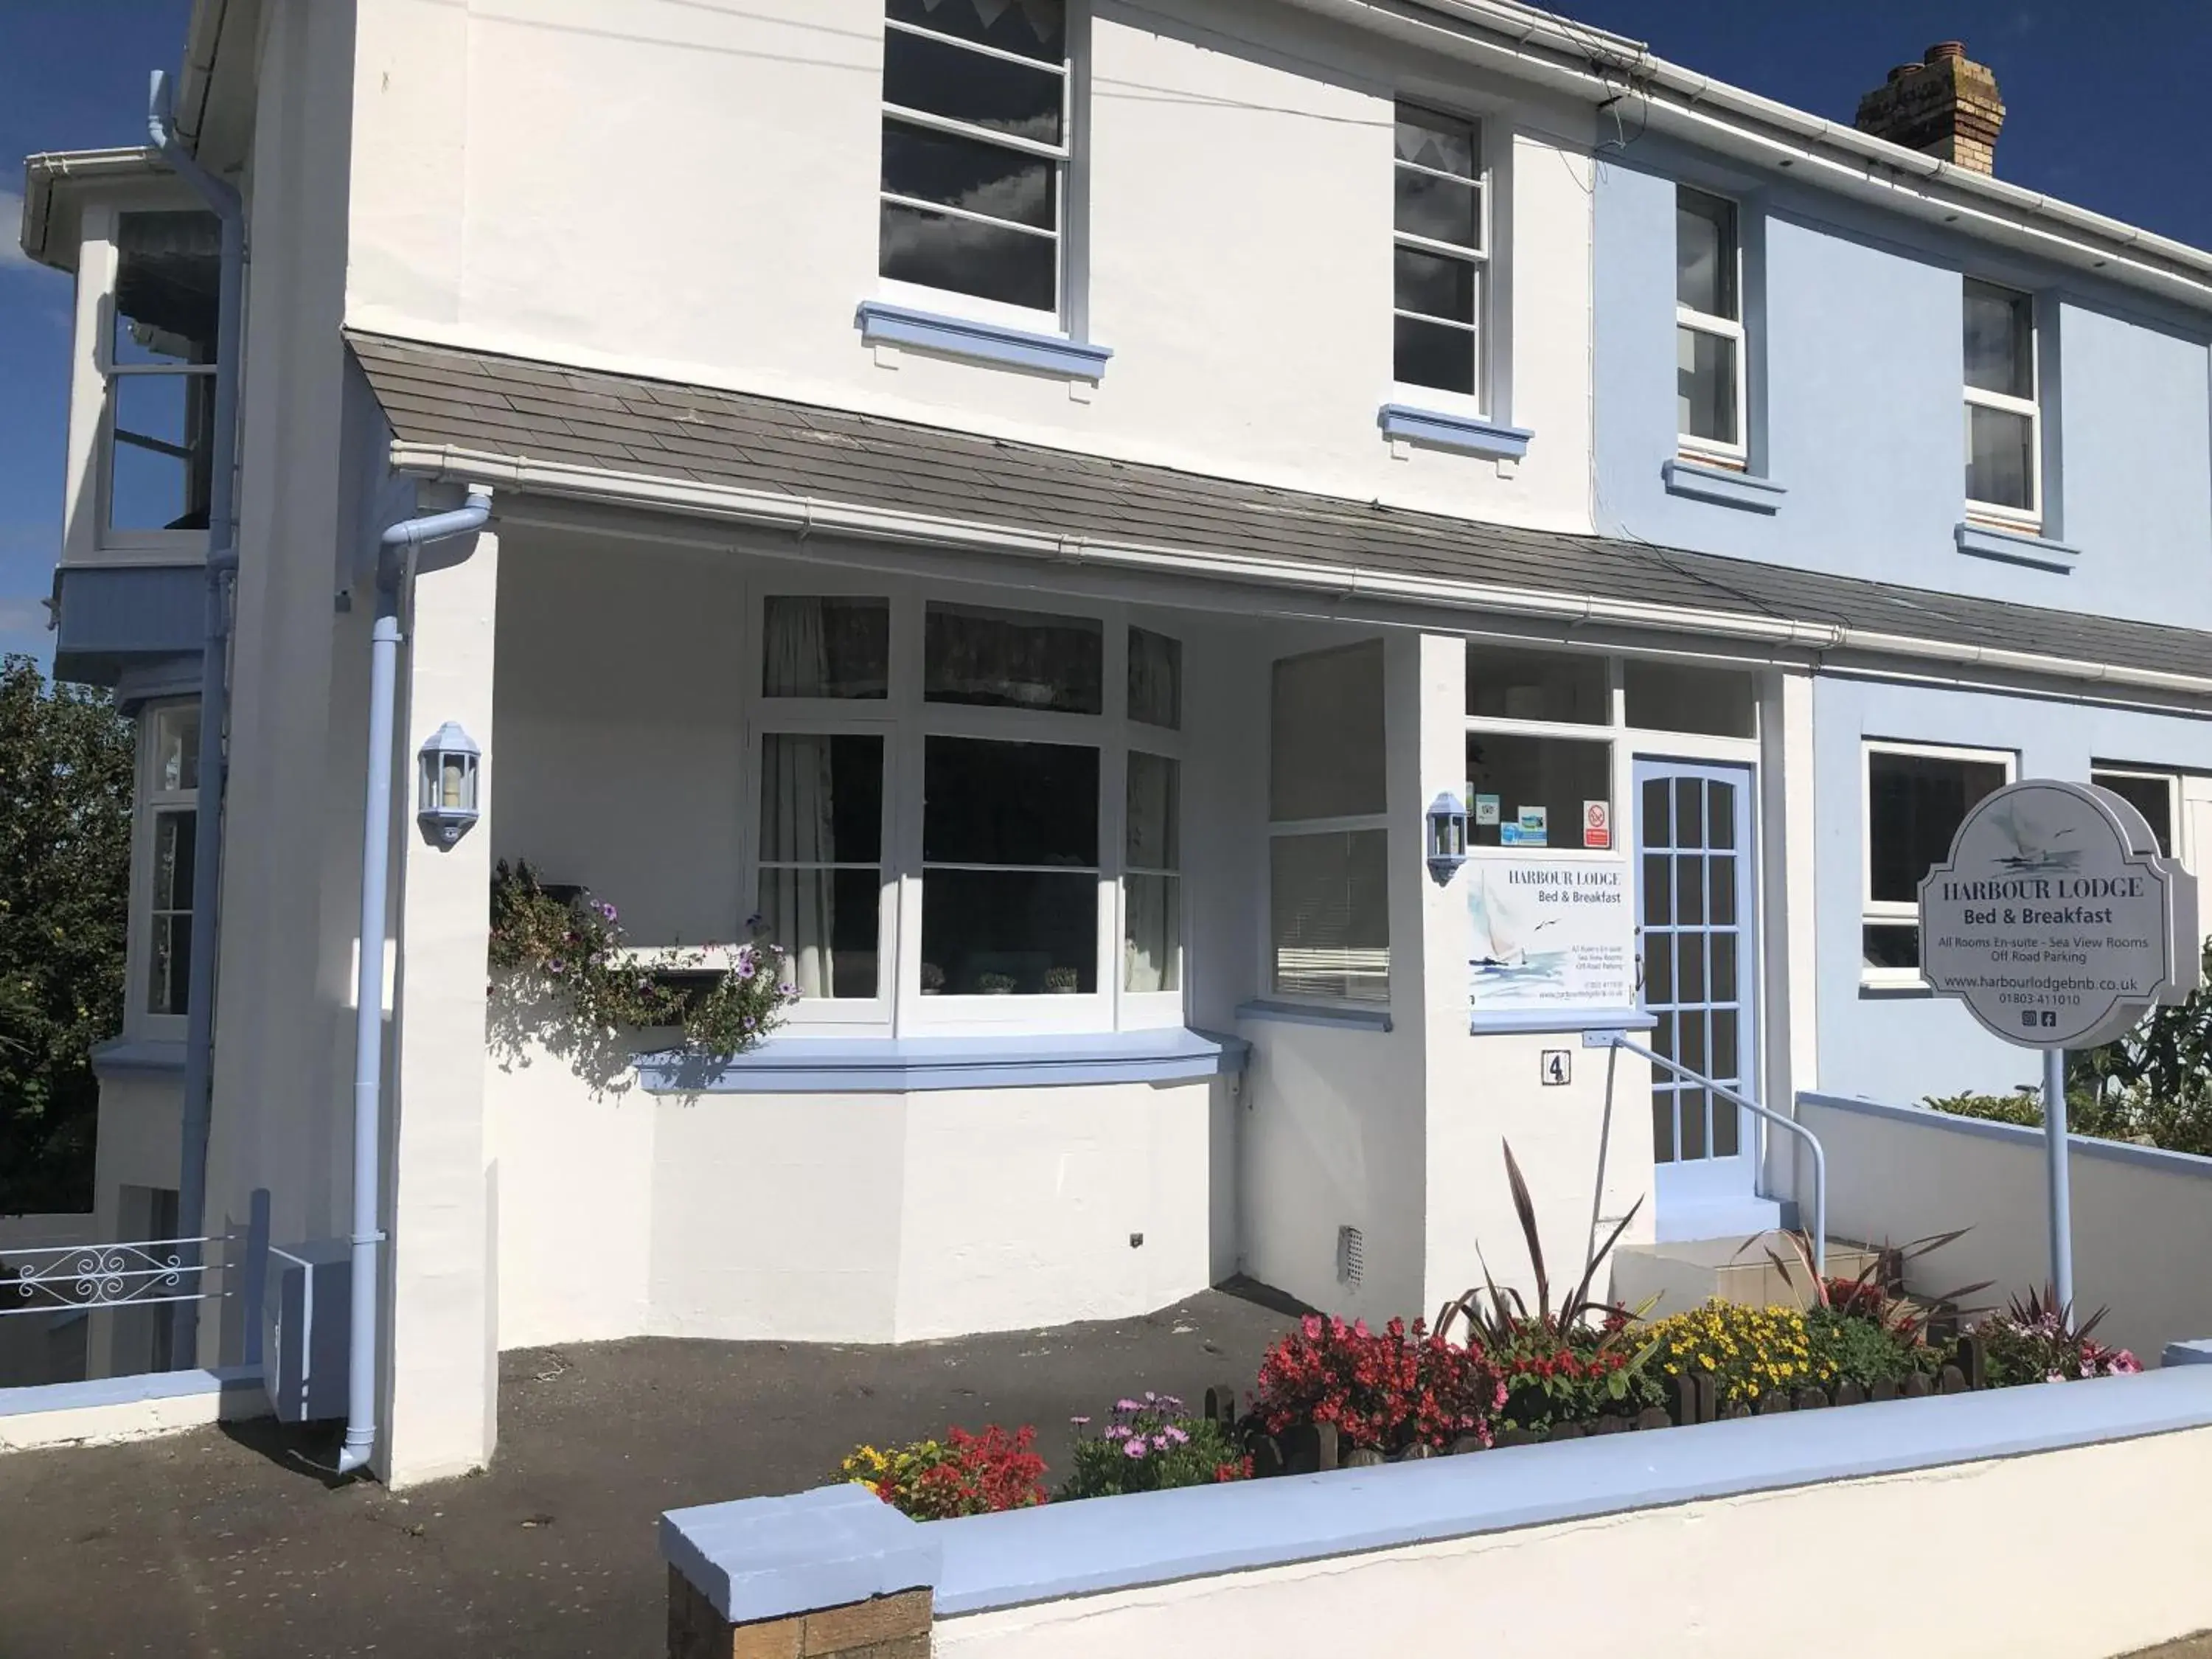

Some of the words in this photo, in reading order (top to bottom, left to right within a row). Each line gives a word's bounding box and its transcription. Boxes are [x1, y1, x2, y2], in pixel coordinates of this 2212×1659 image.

[1509, 869, 1573, 886] HARBOUR
[1576, 870, 1622, 886] LODGE
[1538, 890, 1559, 903] Bed
[1561, 891, 1570, 903] &
[1572, 891, 1621, 904] Breakfast
[1943, 877, 2052, 901] HARBOUR
[2057, 877, 2145, 899] LODGE
[1964, 908, 1997, 925] Bed
[2003, 908, 2017, 925] &
[2021, 906, 2113, 925] Breakfast
[1938, 936, 1952, 947] All
[1954, 936, 1991, 948] Rooms
[1993, 936, 2039, 948] En-suite
[2048, 936, 2070, 948] Sea
[2073, 937, 2103, 948] View
[2106, 937, 2149, 949] Rooms
[1991, 950, 2008, 962] Off
[2011, 950, 2041, 962] Road
[2043, 950, 2087, 966] Parking
[1944, 974, 2138, 992] www.harbourlodgebnb.co.uk
[1999, 992, 2034, 1004] 01803
[2037, 993, 2081, 1005] 411010
[1549, 1054, 1564, 1081] 4
